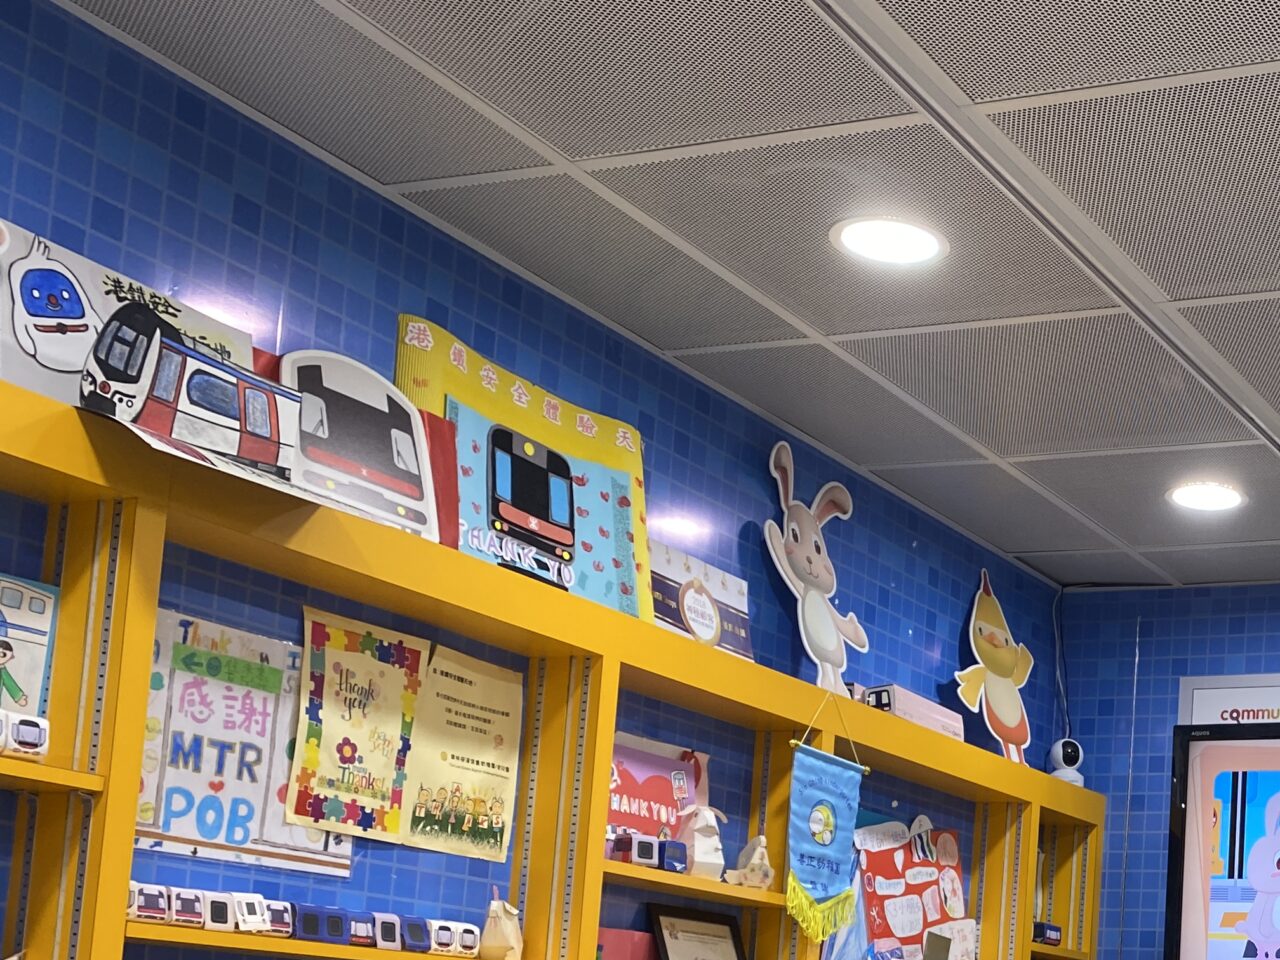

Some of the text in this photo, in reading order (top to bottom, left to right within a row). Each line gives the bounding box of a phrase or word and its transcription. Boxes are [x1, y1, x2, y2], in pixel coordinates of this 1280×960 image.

[178, 619, 232, 655] Thank
[336, 668, 376, 701] thank
[179, 677, 271, 738] 感謝
[341, 696, 369, 721] you
[167, 730, 264, 784] MTR
[162, 786, 256, 846] POB
[610, 792, 677, 825] HANK YOU
